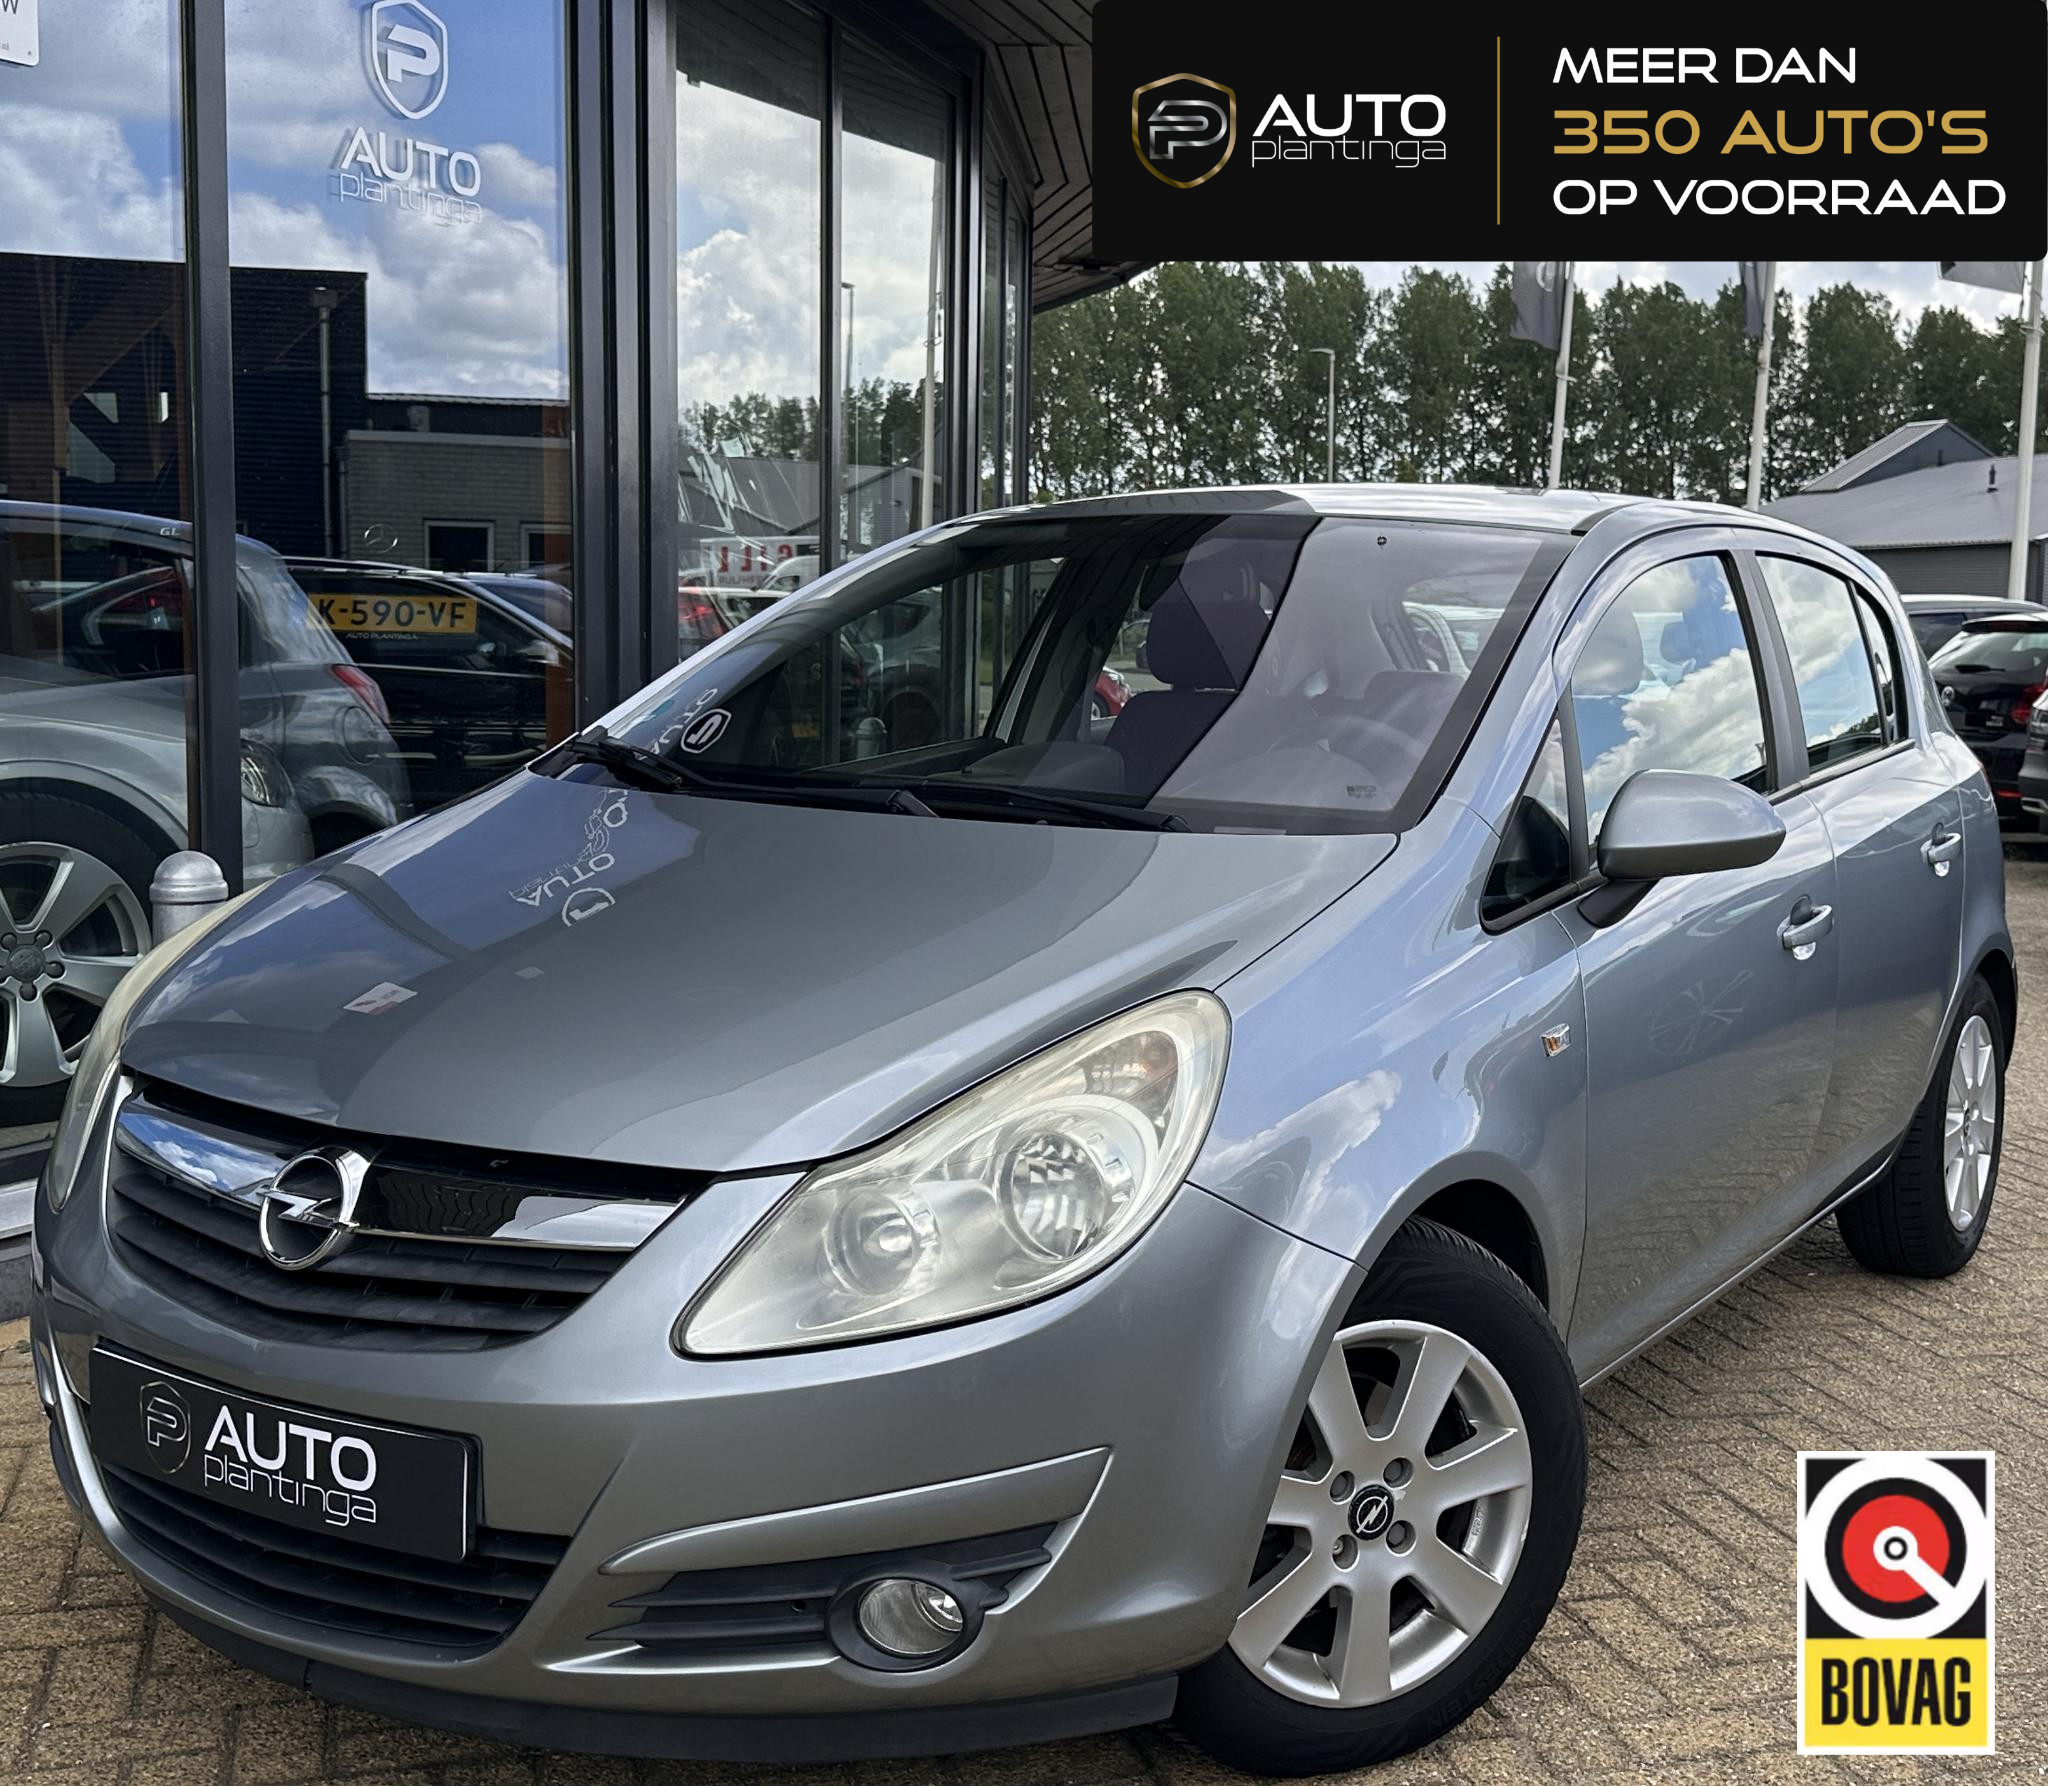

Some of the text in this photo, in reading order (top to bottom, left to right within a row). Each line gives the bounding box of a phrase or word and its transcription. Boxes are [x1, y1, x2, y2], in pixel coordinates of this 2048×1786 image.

[340, 126, 482, 198] AUTO
[340, 172, 482, 224] plantinga
[345, 631, 370, 639] AUTO
[204, 1405, 377, 1492] AUTO
[204, 1454, 377, 1527] plantinga
